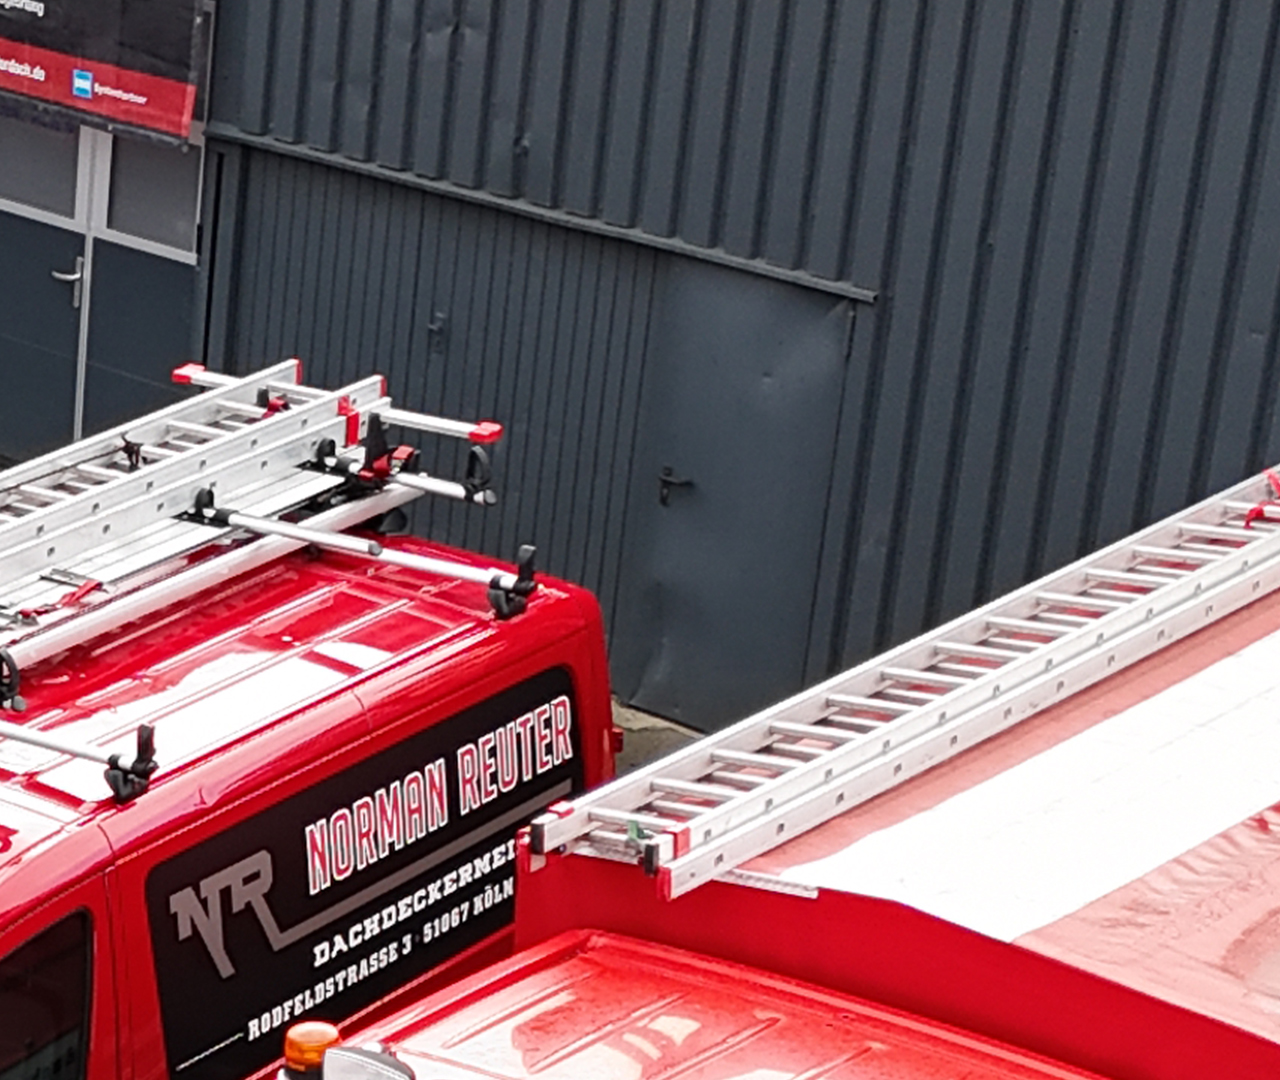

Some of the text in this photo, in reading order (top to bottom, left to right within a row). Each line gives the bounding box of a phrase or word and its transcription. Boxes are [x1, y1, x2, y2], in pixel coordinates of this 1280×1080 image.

[304, 758, 450, 897] NORMAN
[456, 694, 574, 817] REUTER
[247, 876, 515, 1042] RODFELDSTRASSE 3 51067 KÖLN
[312, 838, 518, 968] DACHDECKERMEI
